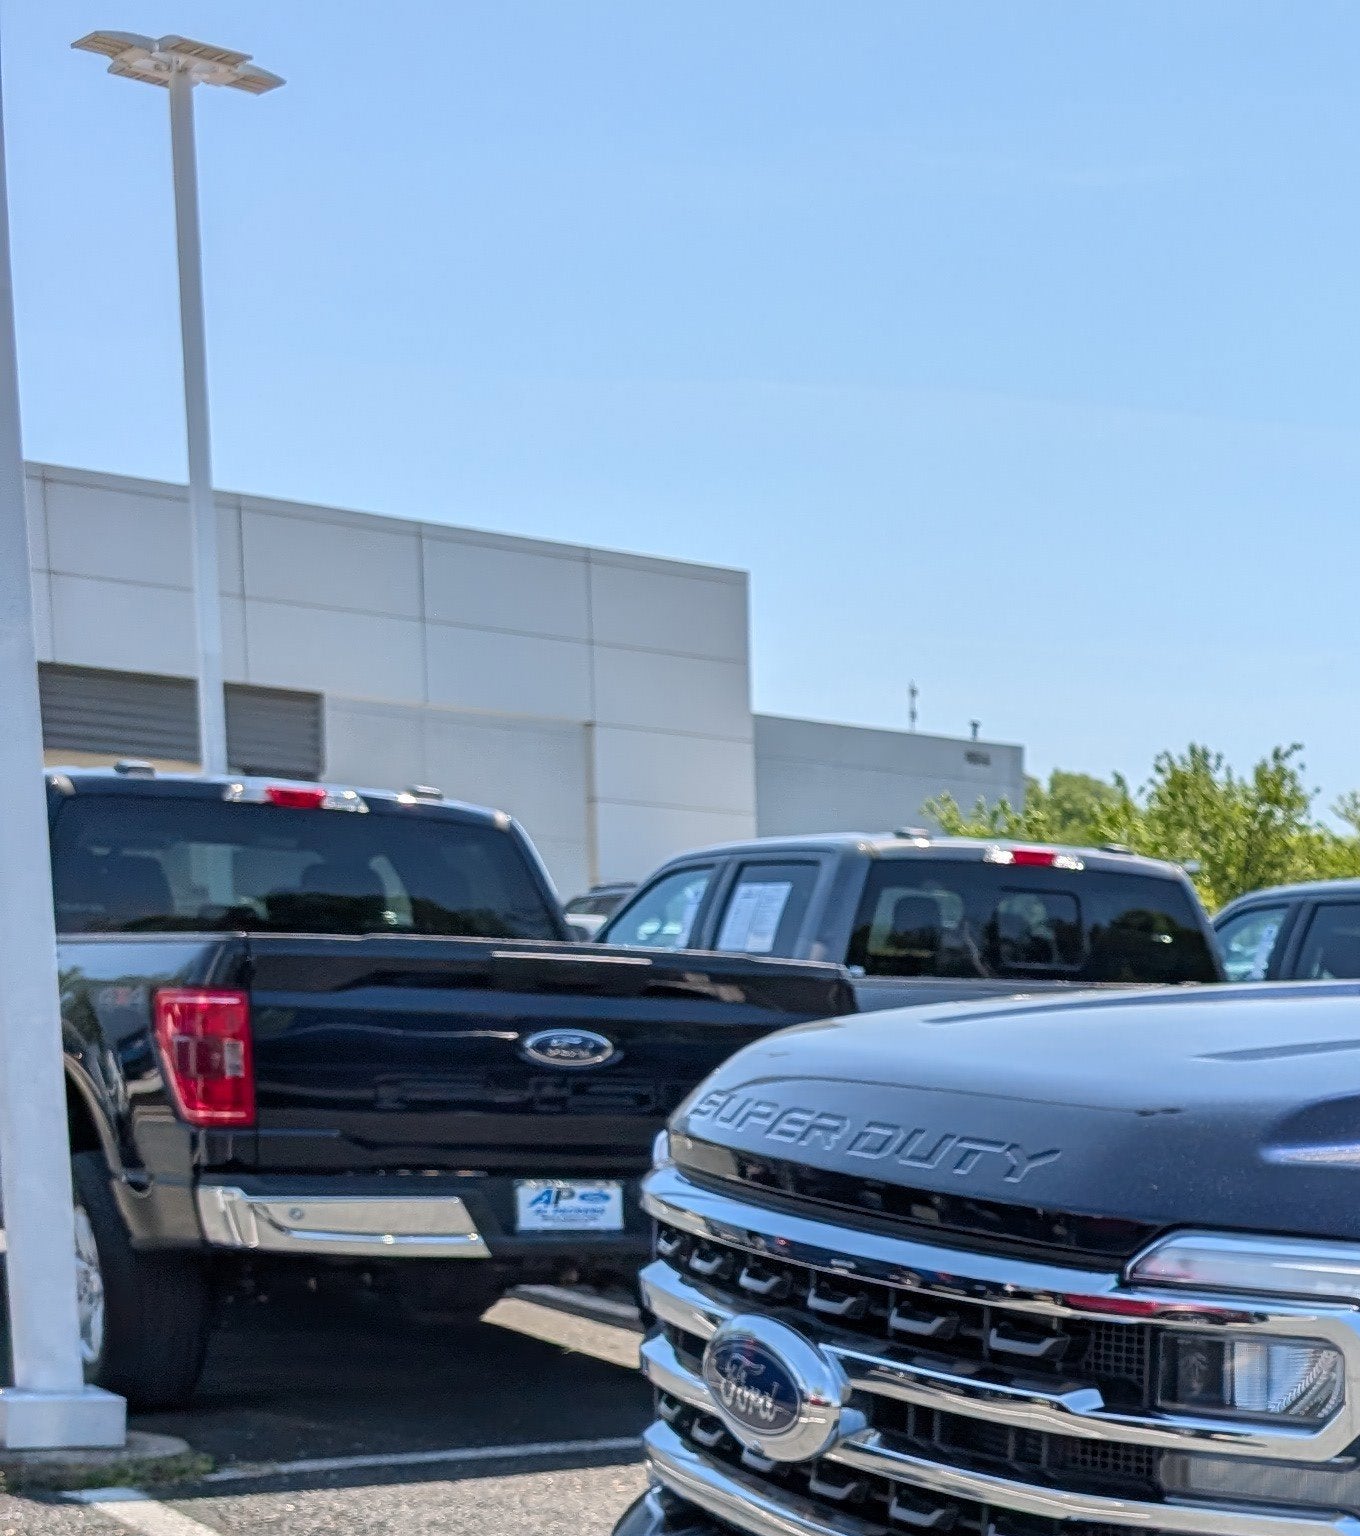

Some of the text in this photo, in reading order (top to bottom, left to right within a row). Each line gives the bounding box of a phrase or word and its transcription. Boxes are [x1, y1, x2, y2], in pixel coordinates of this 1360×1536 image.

[690, 1090, 851, 1151] SUPER
[846, 1120, 1062, 1183] DUTY
[719, 1352, 781, 1423] Ford
